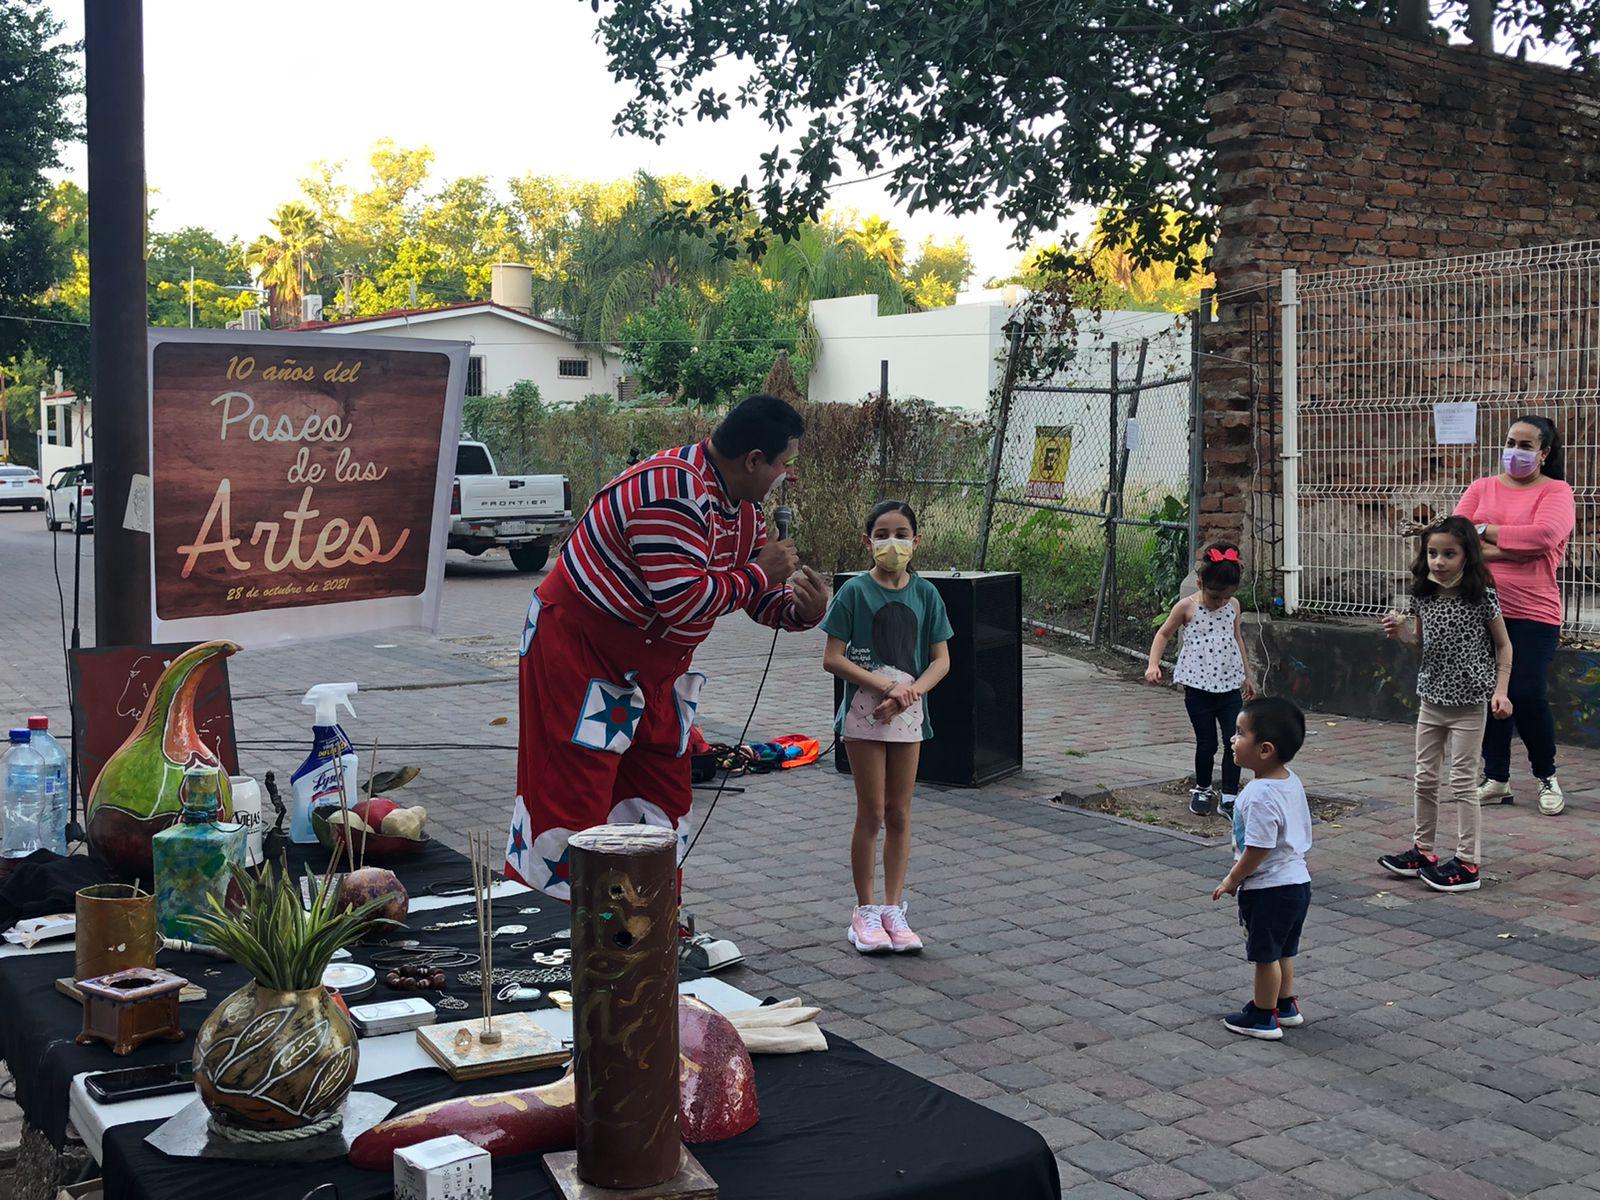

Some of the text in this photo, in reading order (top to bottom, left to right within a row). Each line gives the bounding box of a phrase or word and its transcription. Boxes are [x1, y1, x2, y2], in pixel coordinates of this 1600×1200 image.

[225, 355, 362, 383] 10 años del
[210, 391, 352, 441] Paseo
[287, 446, 388, 483] de las
[176, 478, 410, 578] Artes
[226, 578, 350, 601] 28 de octubre de 2021
